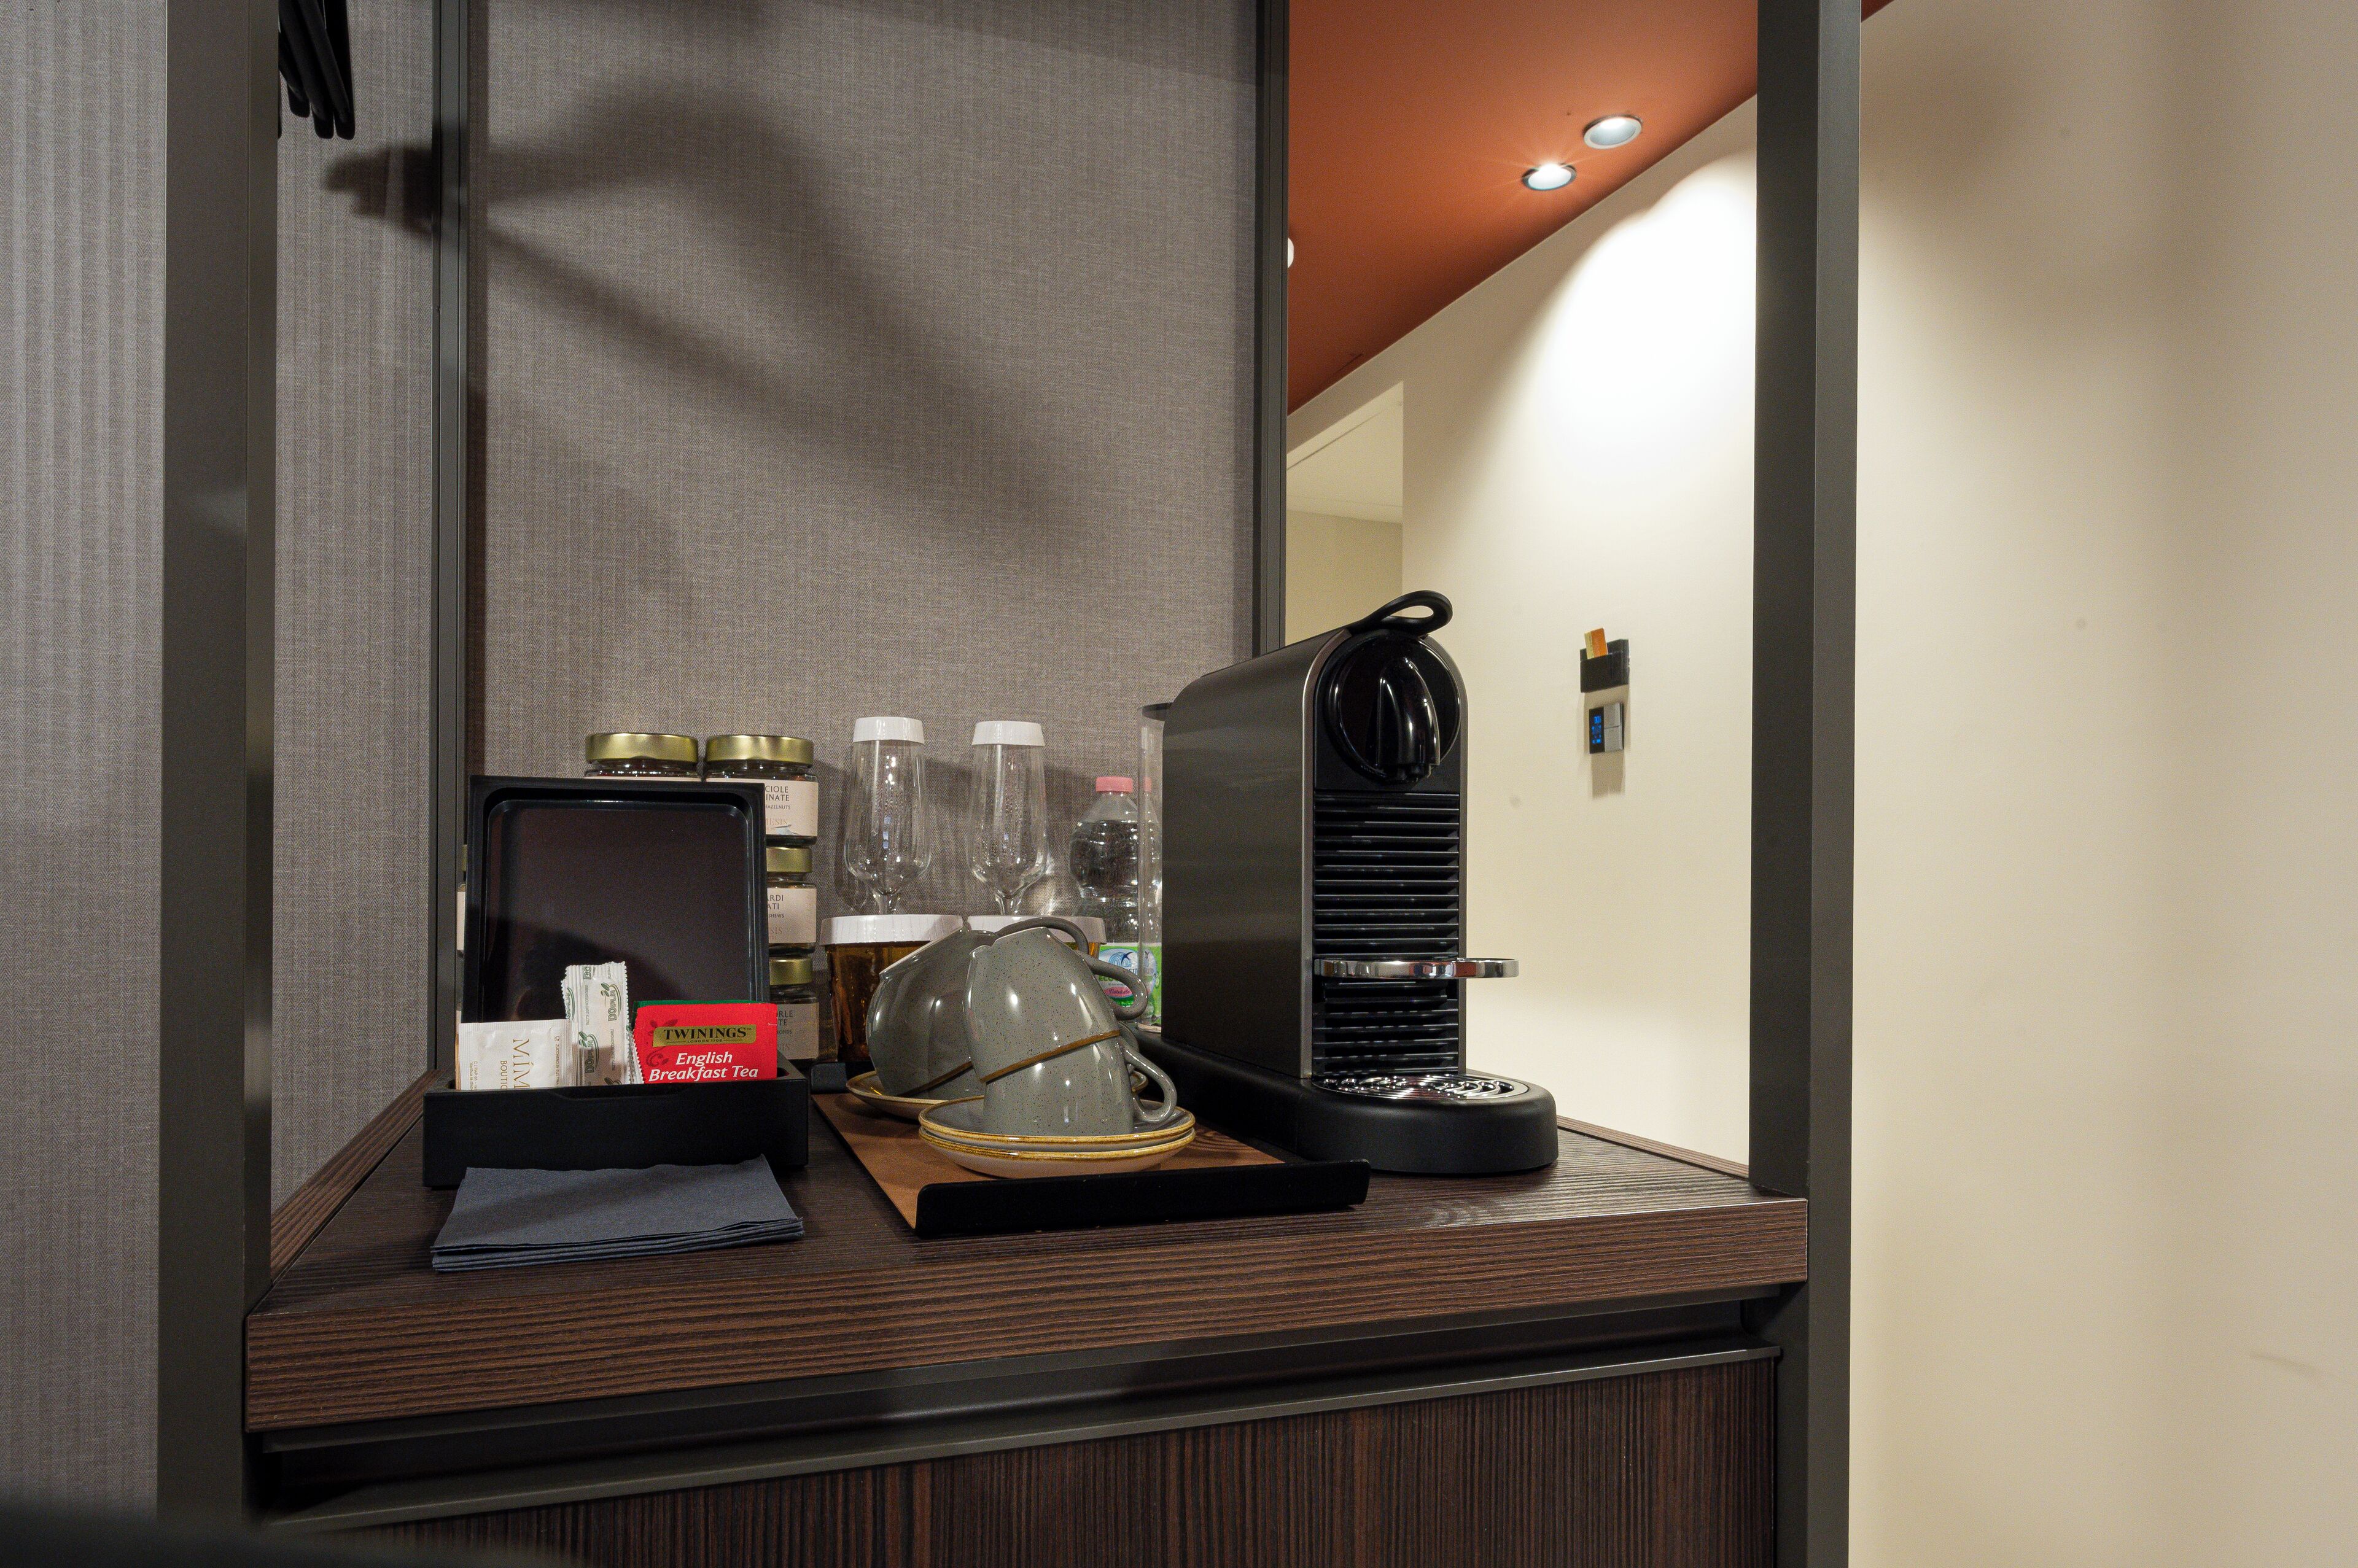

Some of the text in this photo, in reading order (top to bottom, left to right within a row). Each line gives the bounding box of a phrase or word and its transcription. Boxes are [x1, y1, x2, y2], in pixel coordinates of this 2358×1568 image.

[664, 1027, 747, 1040] TWININGS
[675, 1051, 733, 1067] English
[648, 1065, 759, 1082] Breakfast Tea
